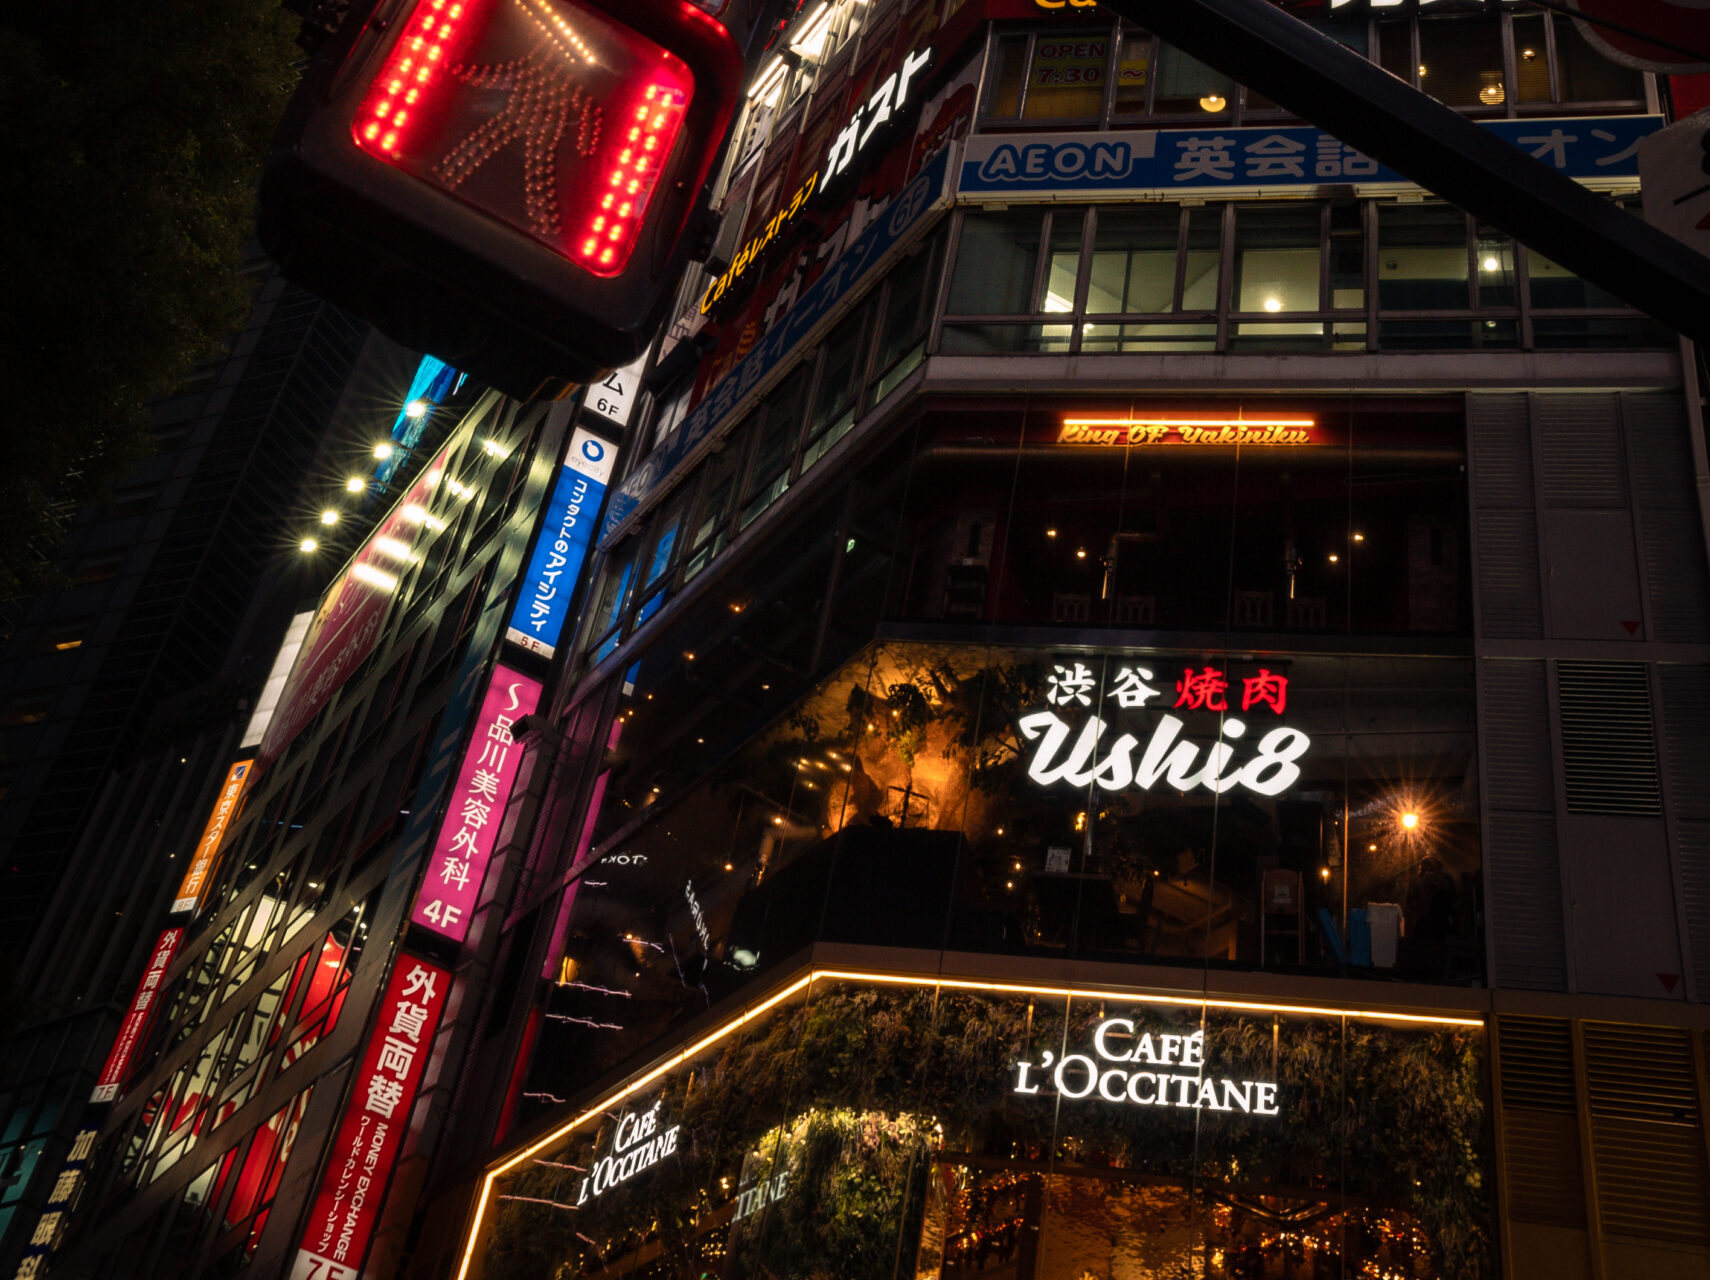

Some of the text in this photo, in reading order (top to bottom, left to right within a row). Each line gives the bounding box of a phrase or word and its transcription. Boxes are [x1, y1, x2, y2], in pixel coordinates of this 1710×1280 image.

[1037, 67, 1101, 85] 7:30
[1038, 42, 1106, 60] OPEN
[818, 46, 932, 195] ガスト
[986, 144, 1127, 176] AEON
[596, 397, 620, 416] 6F
[1056, 424, 1120, 447] King
[1178, 424, 1310, 444] Yakiniku
[519, 635, 541, 651] 5F
[1018, 710, 1312, 797] Ushi8
[439, 713, 514, 892] 品川美容外科
[184, 783, 240, 896] 東京スター銀行
[422, 899, 462, 929] 4F
[134, 930, 178, 1012] 外貨両替
[364, 964, 438, 1120] 外貨両替
[96, 1086, 115, 1100] 7F
[1014, 1050, 1280, 1115] L'OCCITANE
[316, 1115, 371, 1254] ワールドカレンシーショップ
[332, 1121, 389, 1262] MONEY EXCHANGE
[576, 1124, 681, 1207] L'OCCITANE
